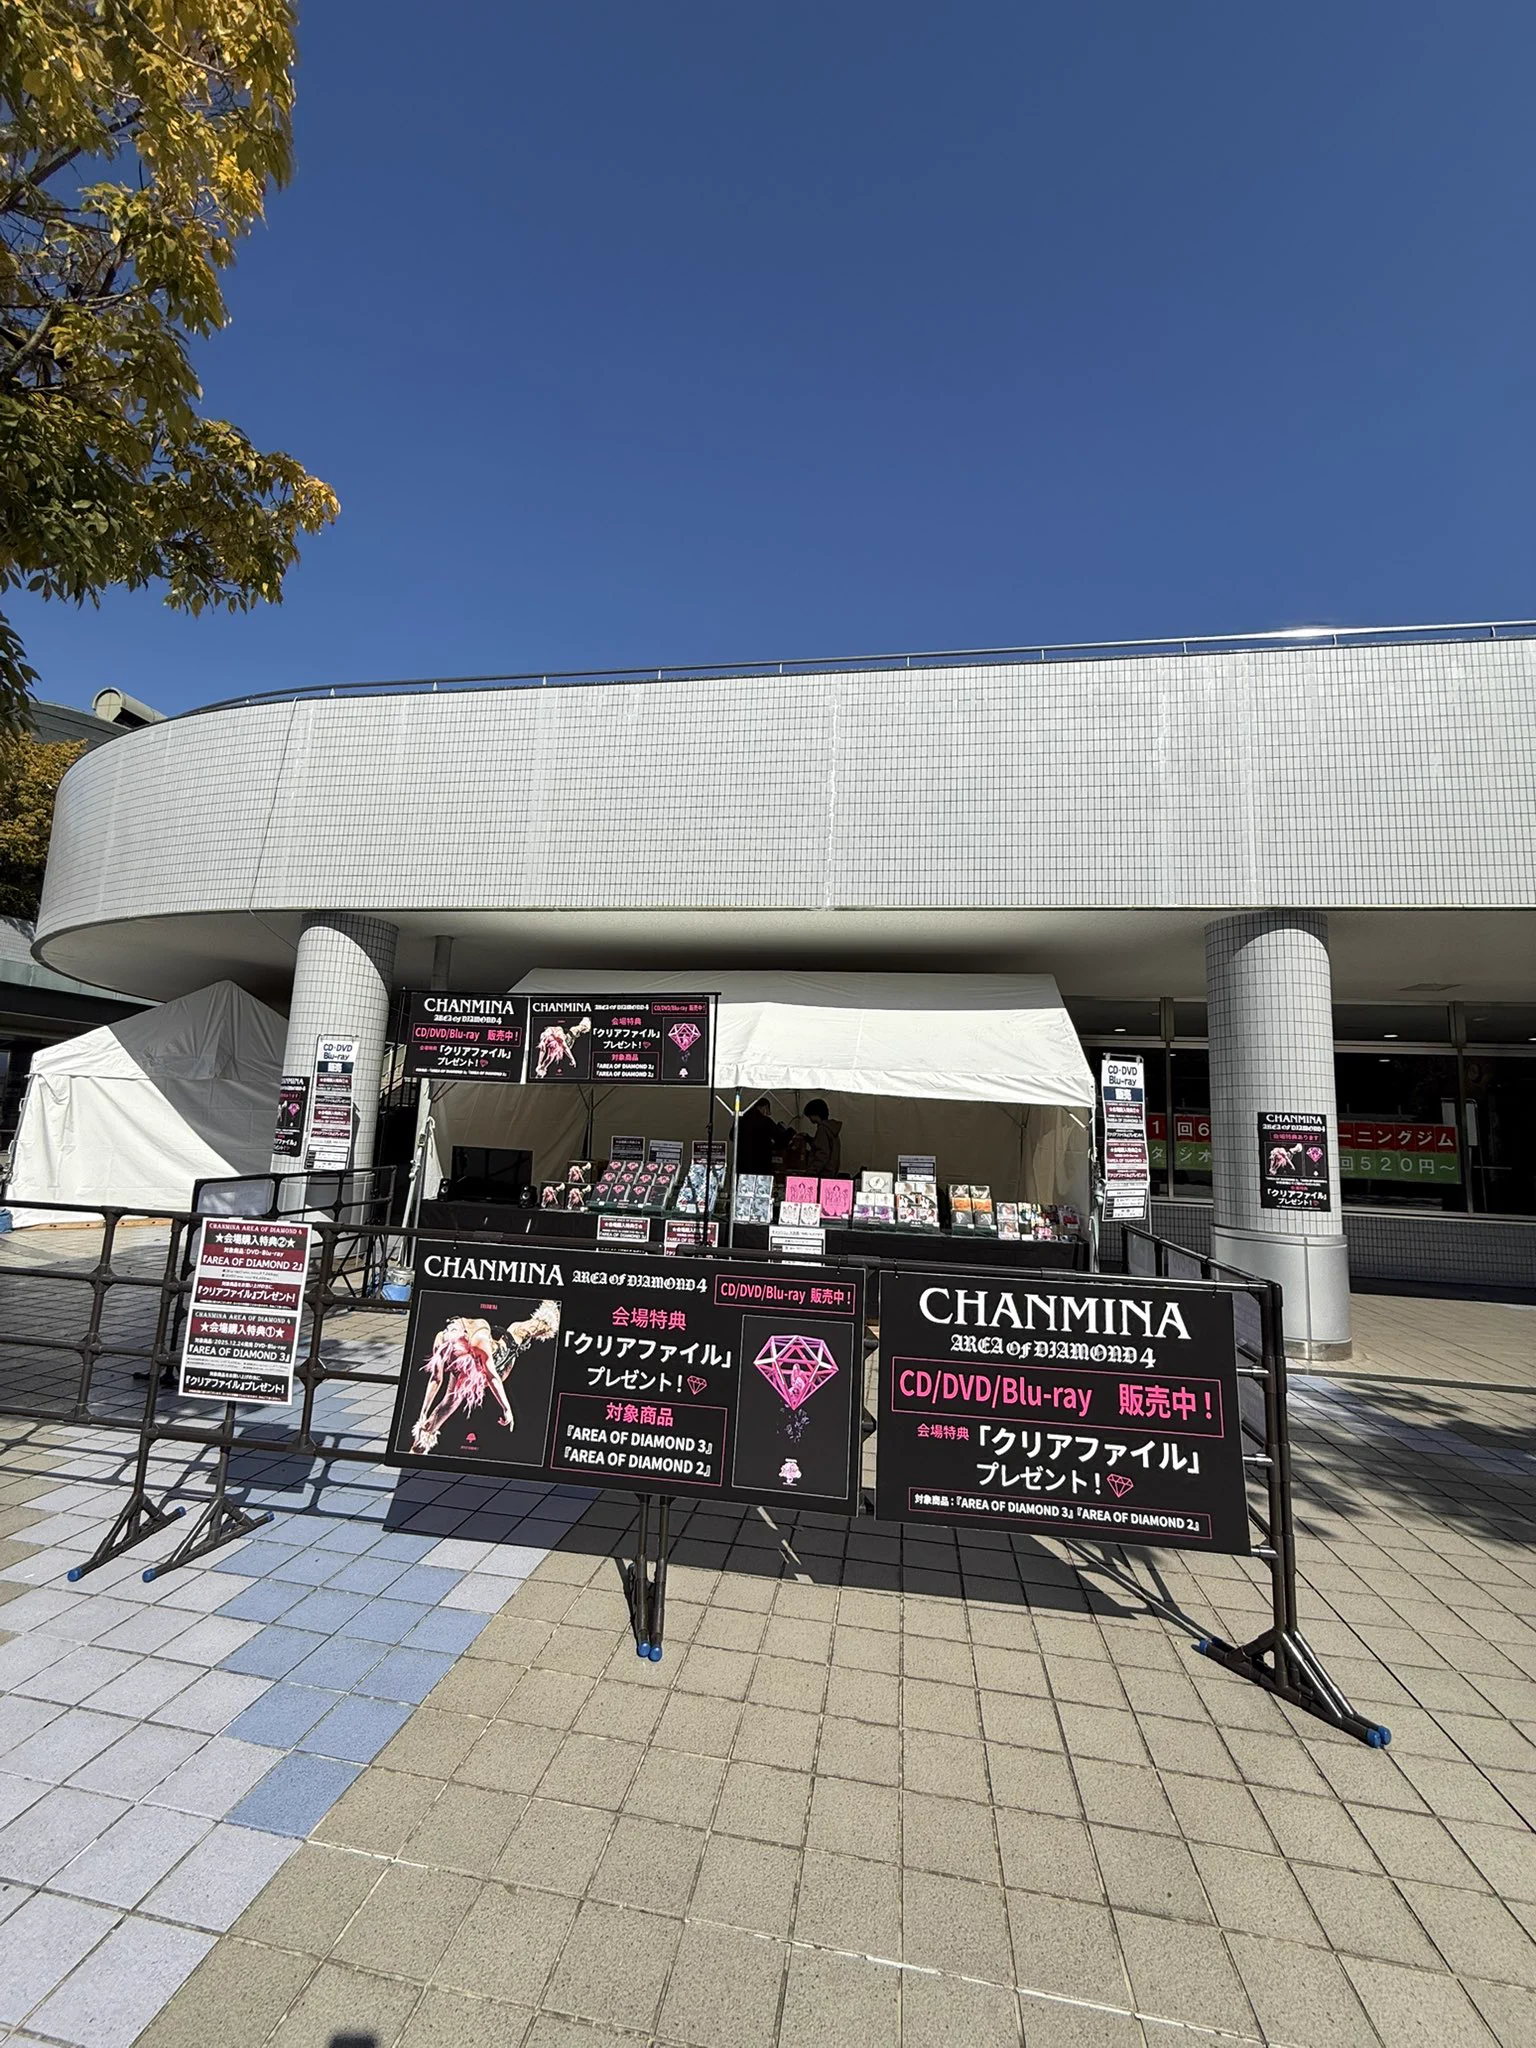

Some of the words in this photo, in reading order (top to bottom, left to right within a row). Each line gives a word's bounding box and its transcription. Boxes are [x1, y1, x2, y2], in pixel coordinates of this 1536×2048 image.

[424, 998, 514, 1014] CHANMINA
[532, 1002, 592, 1012] CHANMINA
[415, 1028, 480, 1041] CD/DVD/Blu-ray
[592, 1028, 660, 1038] 「クリアファイル」
[324, 1052, 350, 1060] Blu-ray
[440, 1045, 511, 1058] 「クリアファイル」
[1109, 1076, 1136, 1086] Blu-ray
[1266, 1114, 1322, 1124] CHANMINA
[202, 1255, 229, 1265] 『AREA
[232, 1257, 244, 1266] OF
[246, 1258, 290, 1270] DIAMOND
[292, 1261, 303, 1271] 2』
[424, 1255, 564, 1286] CHANMINA
[571, 1269, 608, 1285] AREA
[608, 1273, 627, 1287] OF
[627, 1274, 696, 1291] DIAMOND
[696, 1278, 708, 1293] 4
[720, 1283, 805, 1305] CD/DVD/Blu-ray
[810, 1288, 851, 1305] 販売中！
[612, 1306, 687, 1331] 会場特典
[919, 1287, 1192, 1340] CHANMINA
[189, 1344, 216, 1355] 『AREA
[218, 1347, 232, 1356] OF
[233, 1348, 277, 1360] DIAMOND
[280, 1352, 290, 1362] 3』
[564, 1330, 732, 1368] 「クリアファイル」
[950, 1334, 1004, 1355] AREA
[1006, 1341, 1033, 1360] OF
[1034, 1340, 1137, 1364] DIAMOND
[1140, 1348, 1156, 1369] 4
[587, 1366, 682, 1392] プレゼント！
[900, 1369, 1092, 1418] CD/DVD/Blu-ray
[1119, 1383, 1212, 1421] 販売中！
[606, 1402, 674, 1427] 対象商品
[566, 1424, 607, 1443] 『AREA
[610, 1430, 628, 1444] OF
[630, 1433, 695, 1451] DIAMOND
[697, 1440, 712, 1454] 3』
[917, 1423, 970, 1440] 会場特典
[978, 1424, 1200, 1475] 「クリアファイル」
[564, 1446, 604, 1465] 『AREA
[608, 1452, 626, 1466] OF
[628, 1454, 693, 1473] DIAMOND
[696, 1462, 711, 1477] 2』
[977, 1462, 1101, 1495] プレゼント！
[992, 1500, 1006, 1512] OF
[1008, 1502, 1059, 1517] DIAMOND
[1113, 1512, 1129, 1523] OF
[1130, 1513, 1185, 1529] DIAMOND
[1186, 1518, 1200, 1532] 2』
